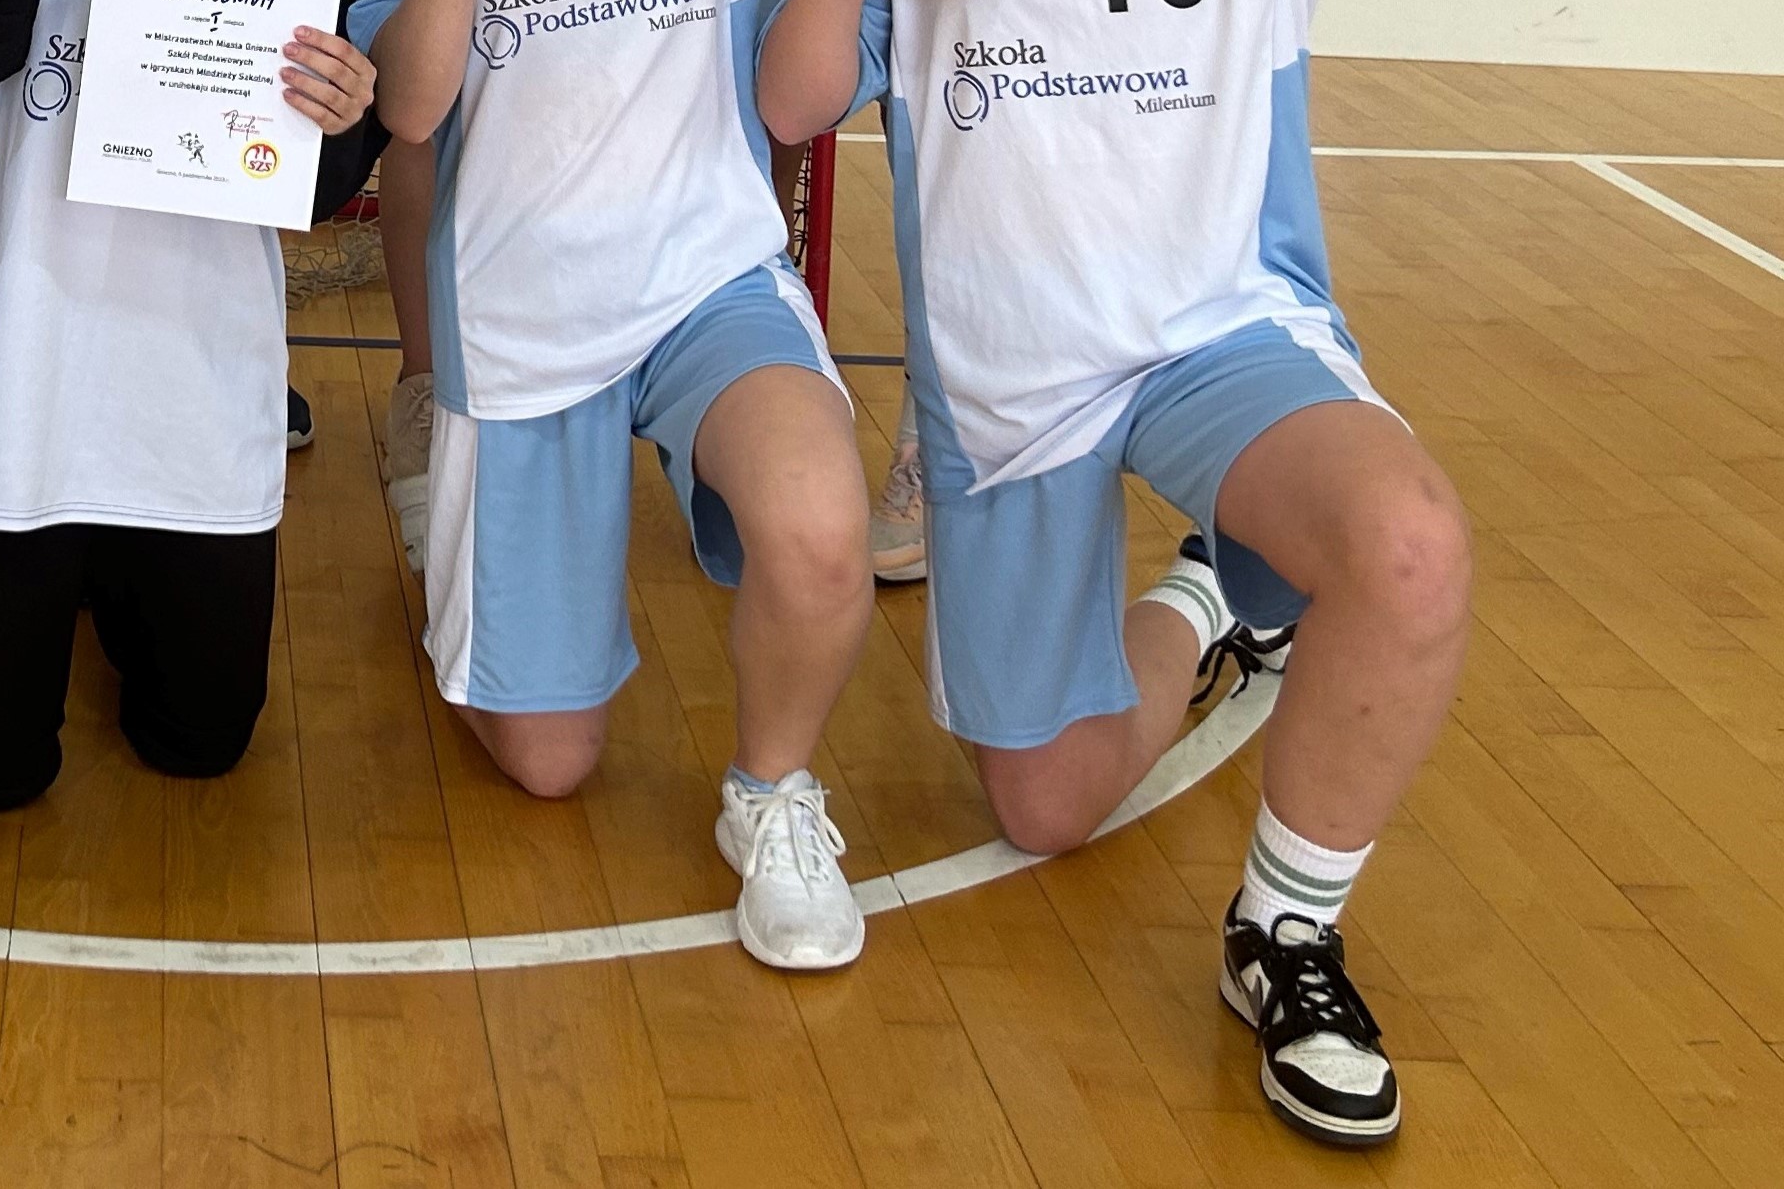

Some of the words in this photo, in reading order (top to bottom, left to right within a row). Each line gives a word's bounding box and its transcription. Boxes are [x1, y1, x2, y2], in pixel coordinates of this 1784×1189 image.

[647, 7, 718, 32] Milenium
[953, 39, 1047, 68] Szkoła
[990, 68, 1189, 100] Podstawowa
[1133, 93, 1217, 115] Milenium
[102, 143, 153, 158] GNIEZNO
[247, 160, 273, 172] SZS
